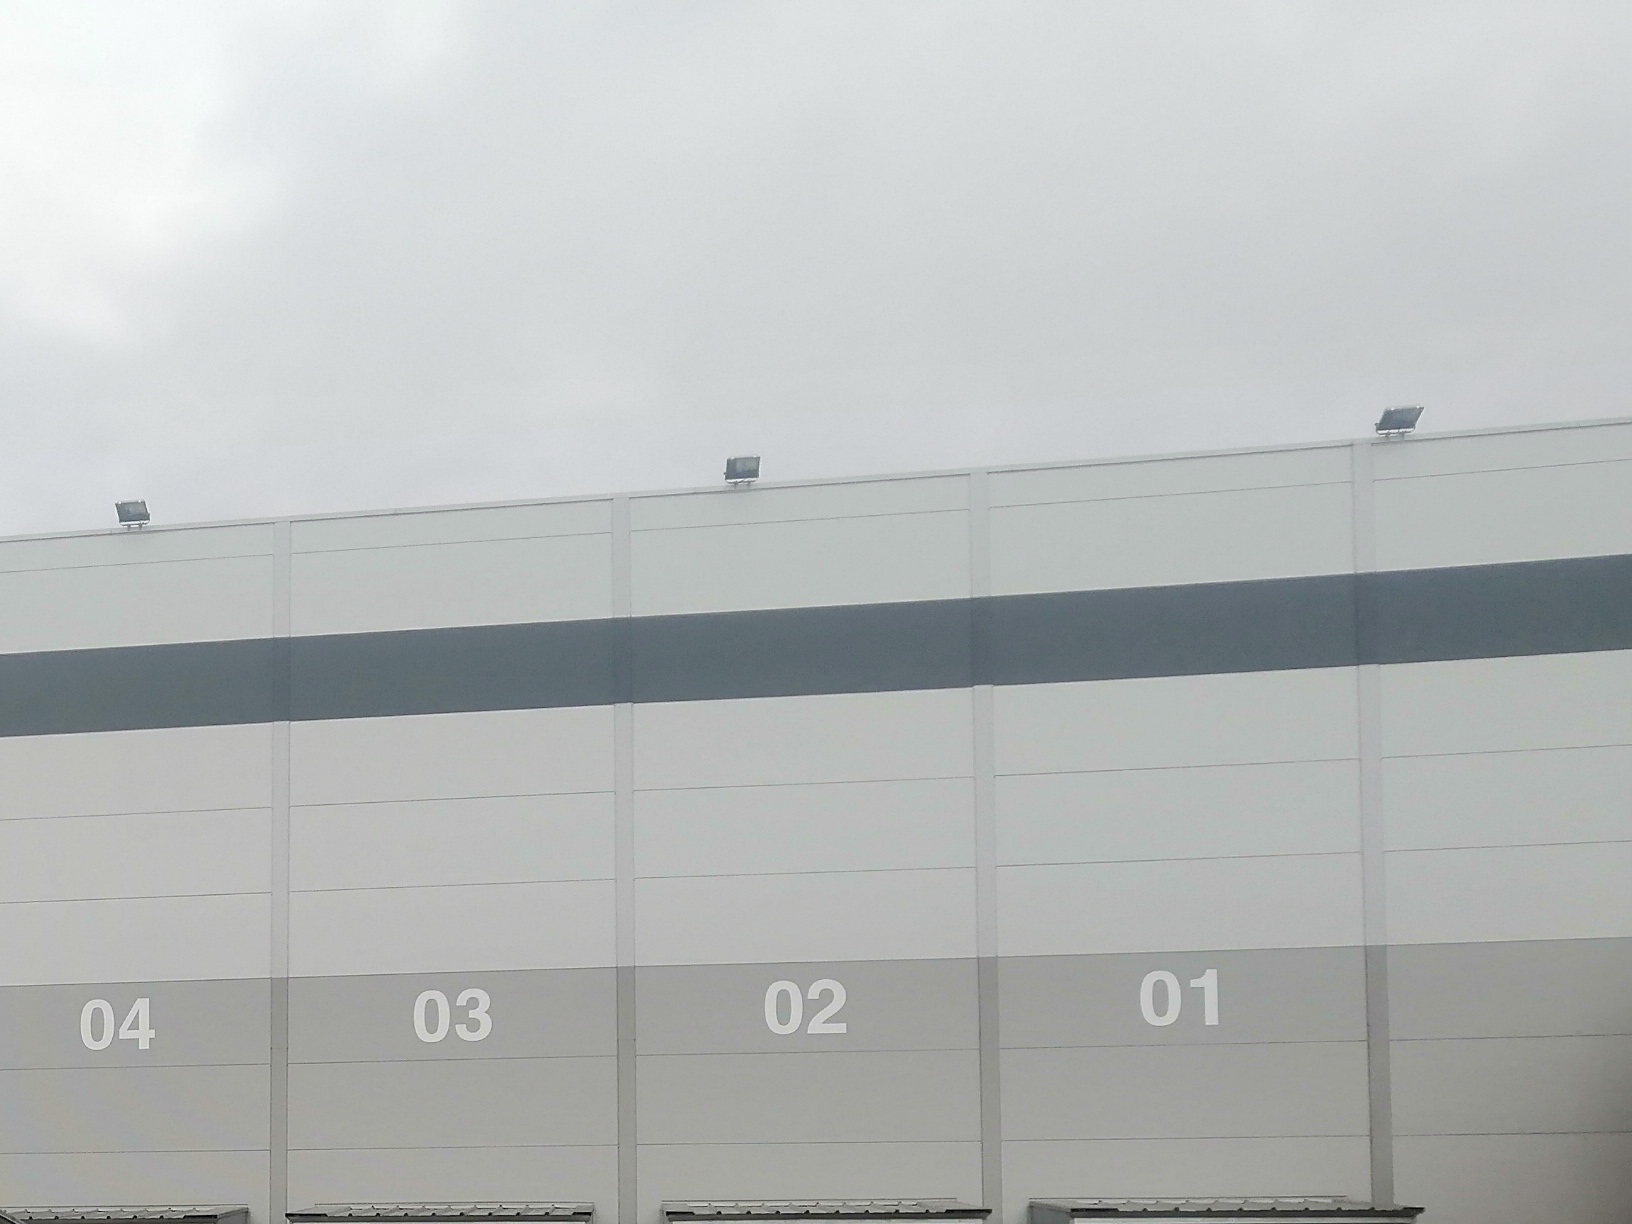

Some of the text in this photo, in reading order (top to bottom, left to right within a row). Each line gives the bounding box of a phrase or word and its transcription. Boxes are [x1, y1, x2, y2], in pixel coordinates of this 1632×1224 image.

[78, 998, 156, 1051] 04
[412, 987, 494, 1043] 03
[763, 978, 848, 1035] 02
[1138, 968, 1221, 1027] 01
